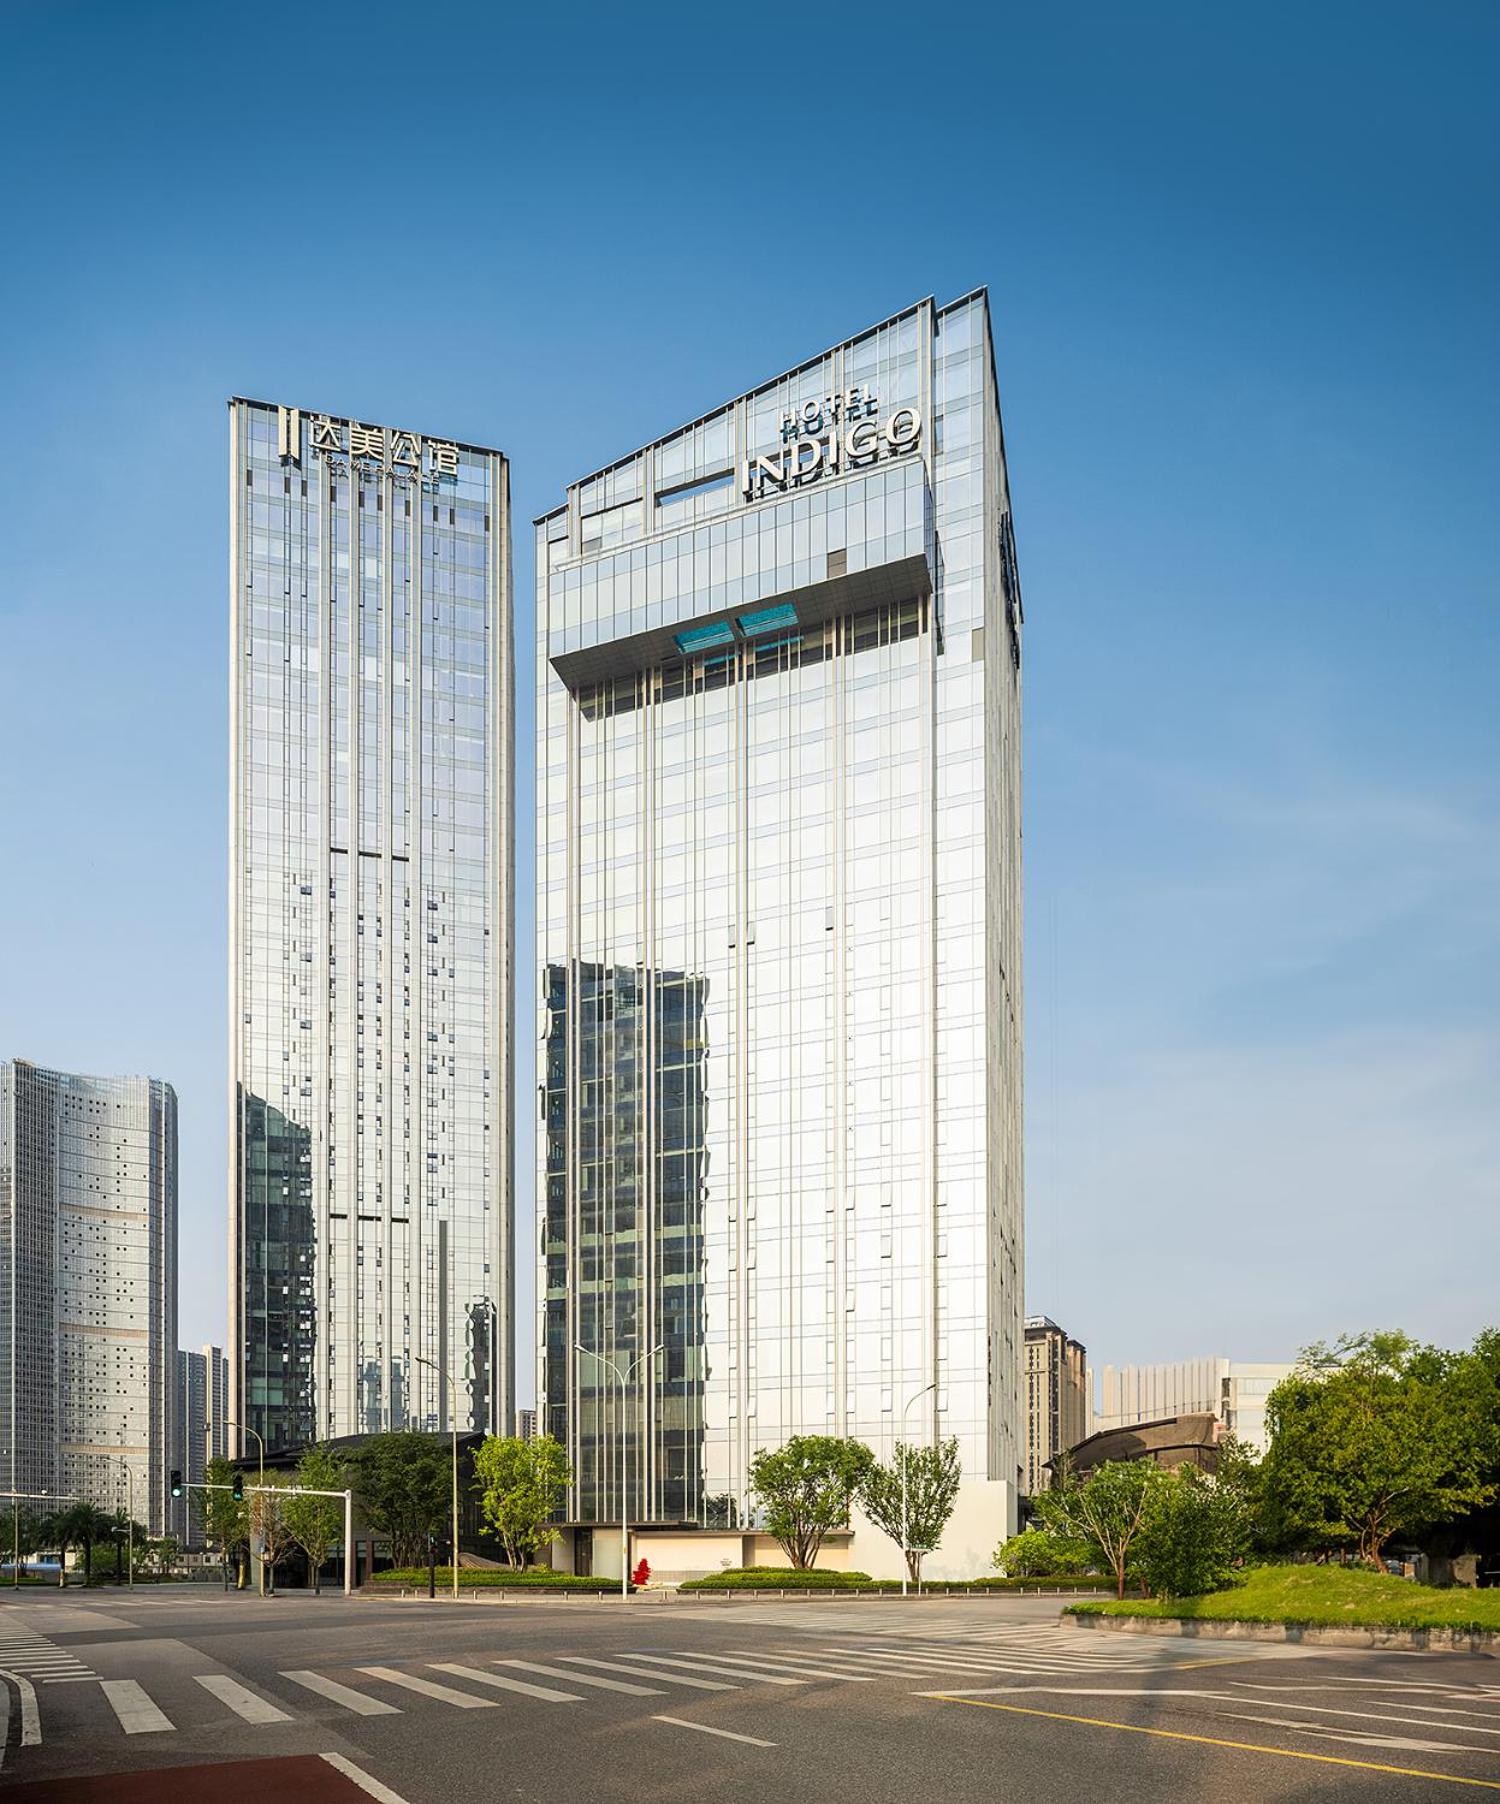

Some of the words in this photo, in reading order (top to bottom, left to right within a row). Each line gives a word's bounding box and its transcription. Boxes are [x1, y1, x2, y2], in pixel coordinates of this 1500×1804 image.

[780, 384, 878, 431] HOTEL
[309, 415, 459, 475] 达美公馆
[742, 408, 921, 492] INDIGO
